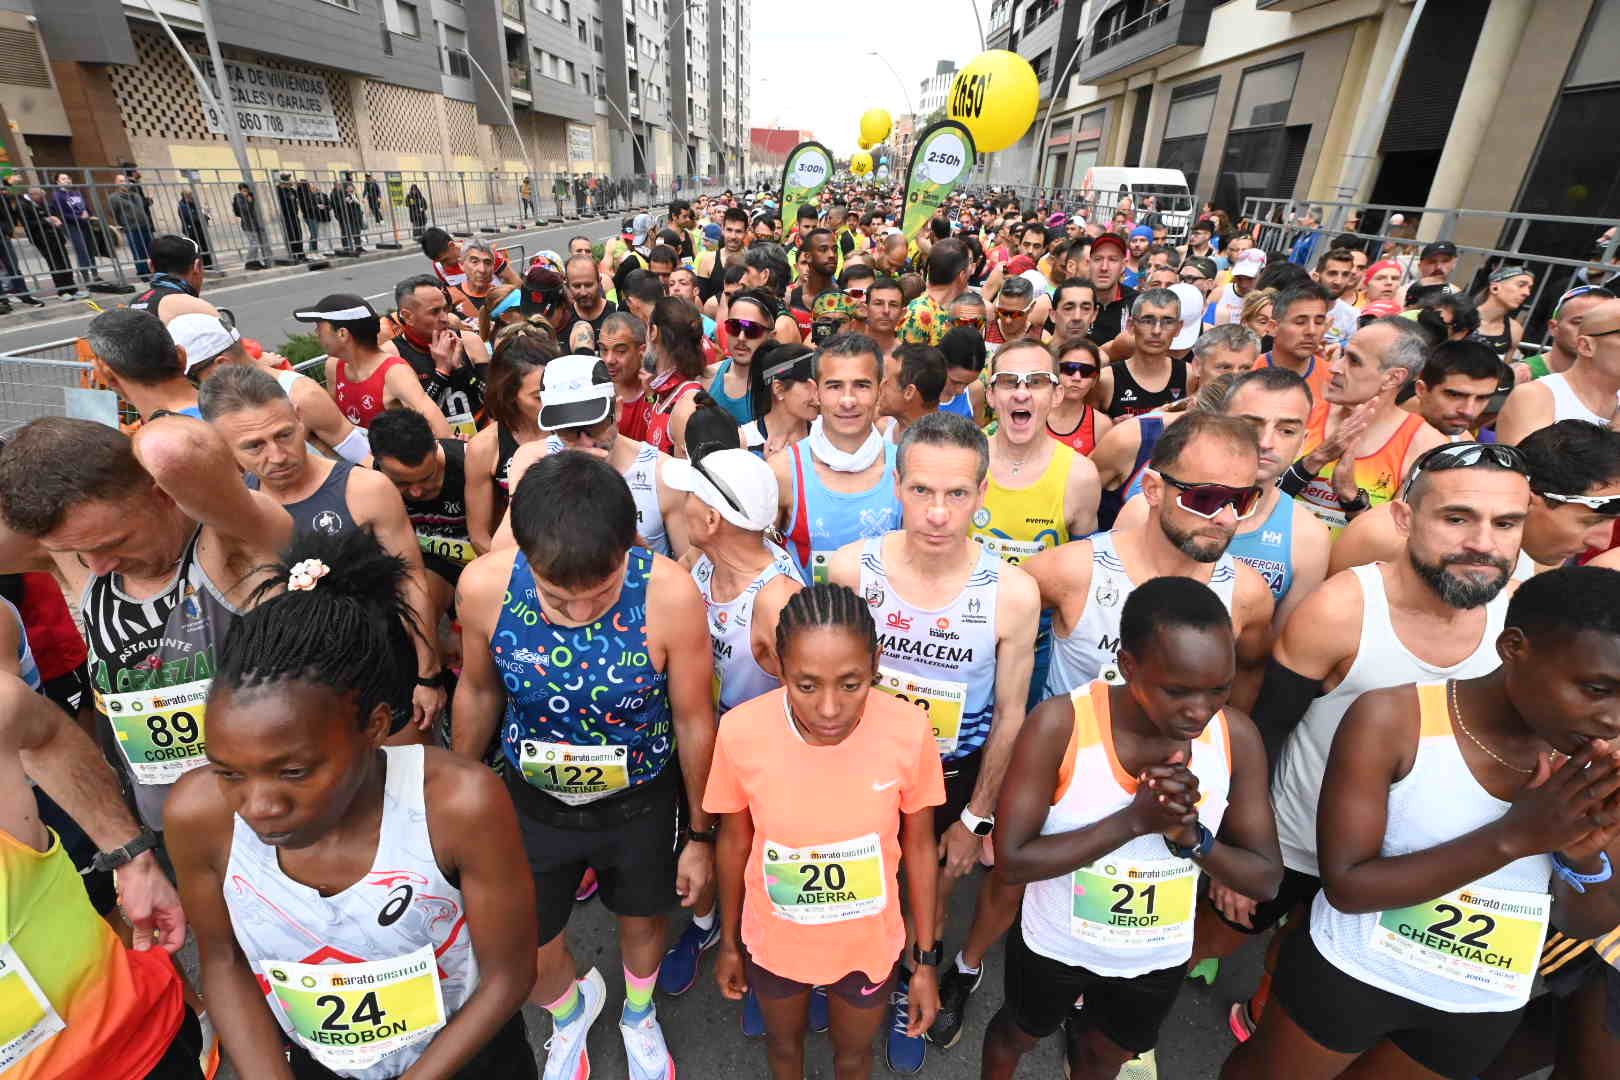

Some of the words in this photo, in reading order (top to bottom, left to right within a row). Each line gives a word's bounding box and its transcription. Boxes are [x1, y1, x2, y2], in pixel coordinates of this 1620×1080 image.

[193, 60, 244, 83] VETA
[247, 67, 265, 86] DE
[266, 71, 326, 95] VIVIENDAS
[211, 83, 269, 105] LCALES
[277, 94, 322, 113] GARAJES
[237, 111, 262, 130] 860
[263, 114, 285, 133] 708
[799, 163, 824, 174] 3:00h
[928, 151, 961, 167] 2:50h
[1262, 530, 1283, 545] HH
[428, 539, 464, 561] 103
[510, 601, 538, 626] JIO
[495, 655, 525, 674] RINGS
[617, 651, 648, 667] JIO
[615, 696, 643, 710] JIO
[147, 711, 199, 748] 89
[543, 765, 605, 785] 122
[800, 863, 846, 892] 20
[797, 891, 857, 904] ADERRA
[1111, 883, 1156, 915] 21
[1107, 914, 1159, 927] JEROP
[1427, 904, 1496, 950] 22
[1398, 923, 1513, 969] CHEPKIACH
[316, 992, 386, 1031] 24
[310, 1019, 407, 1045] JEROBON
